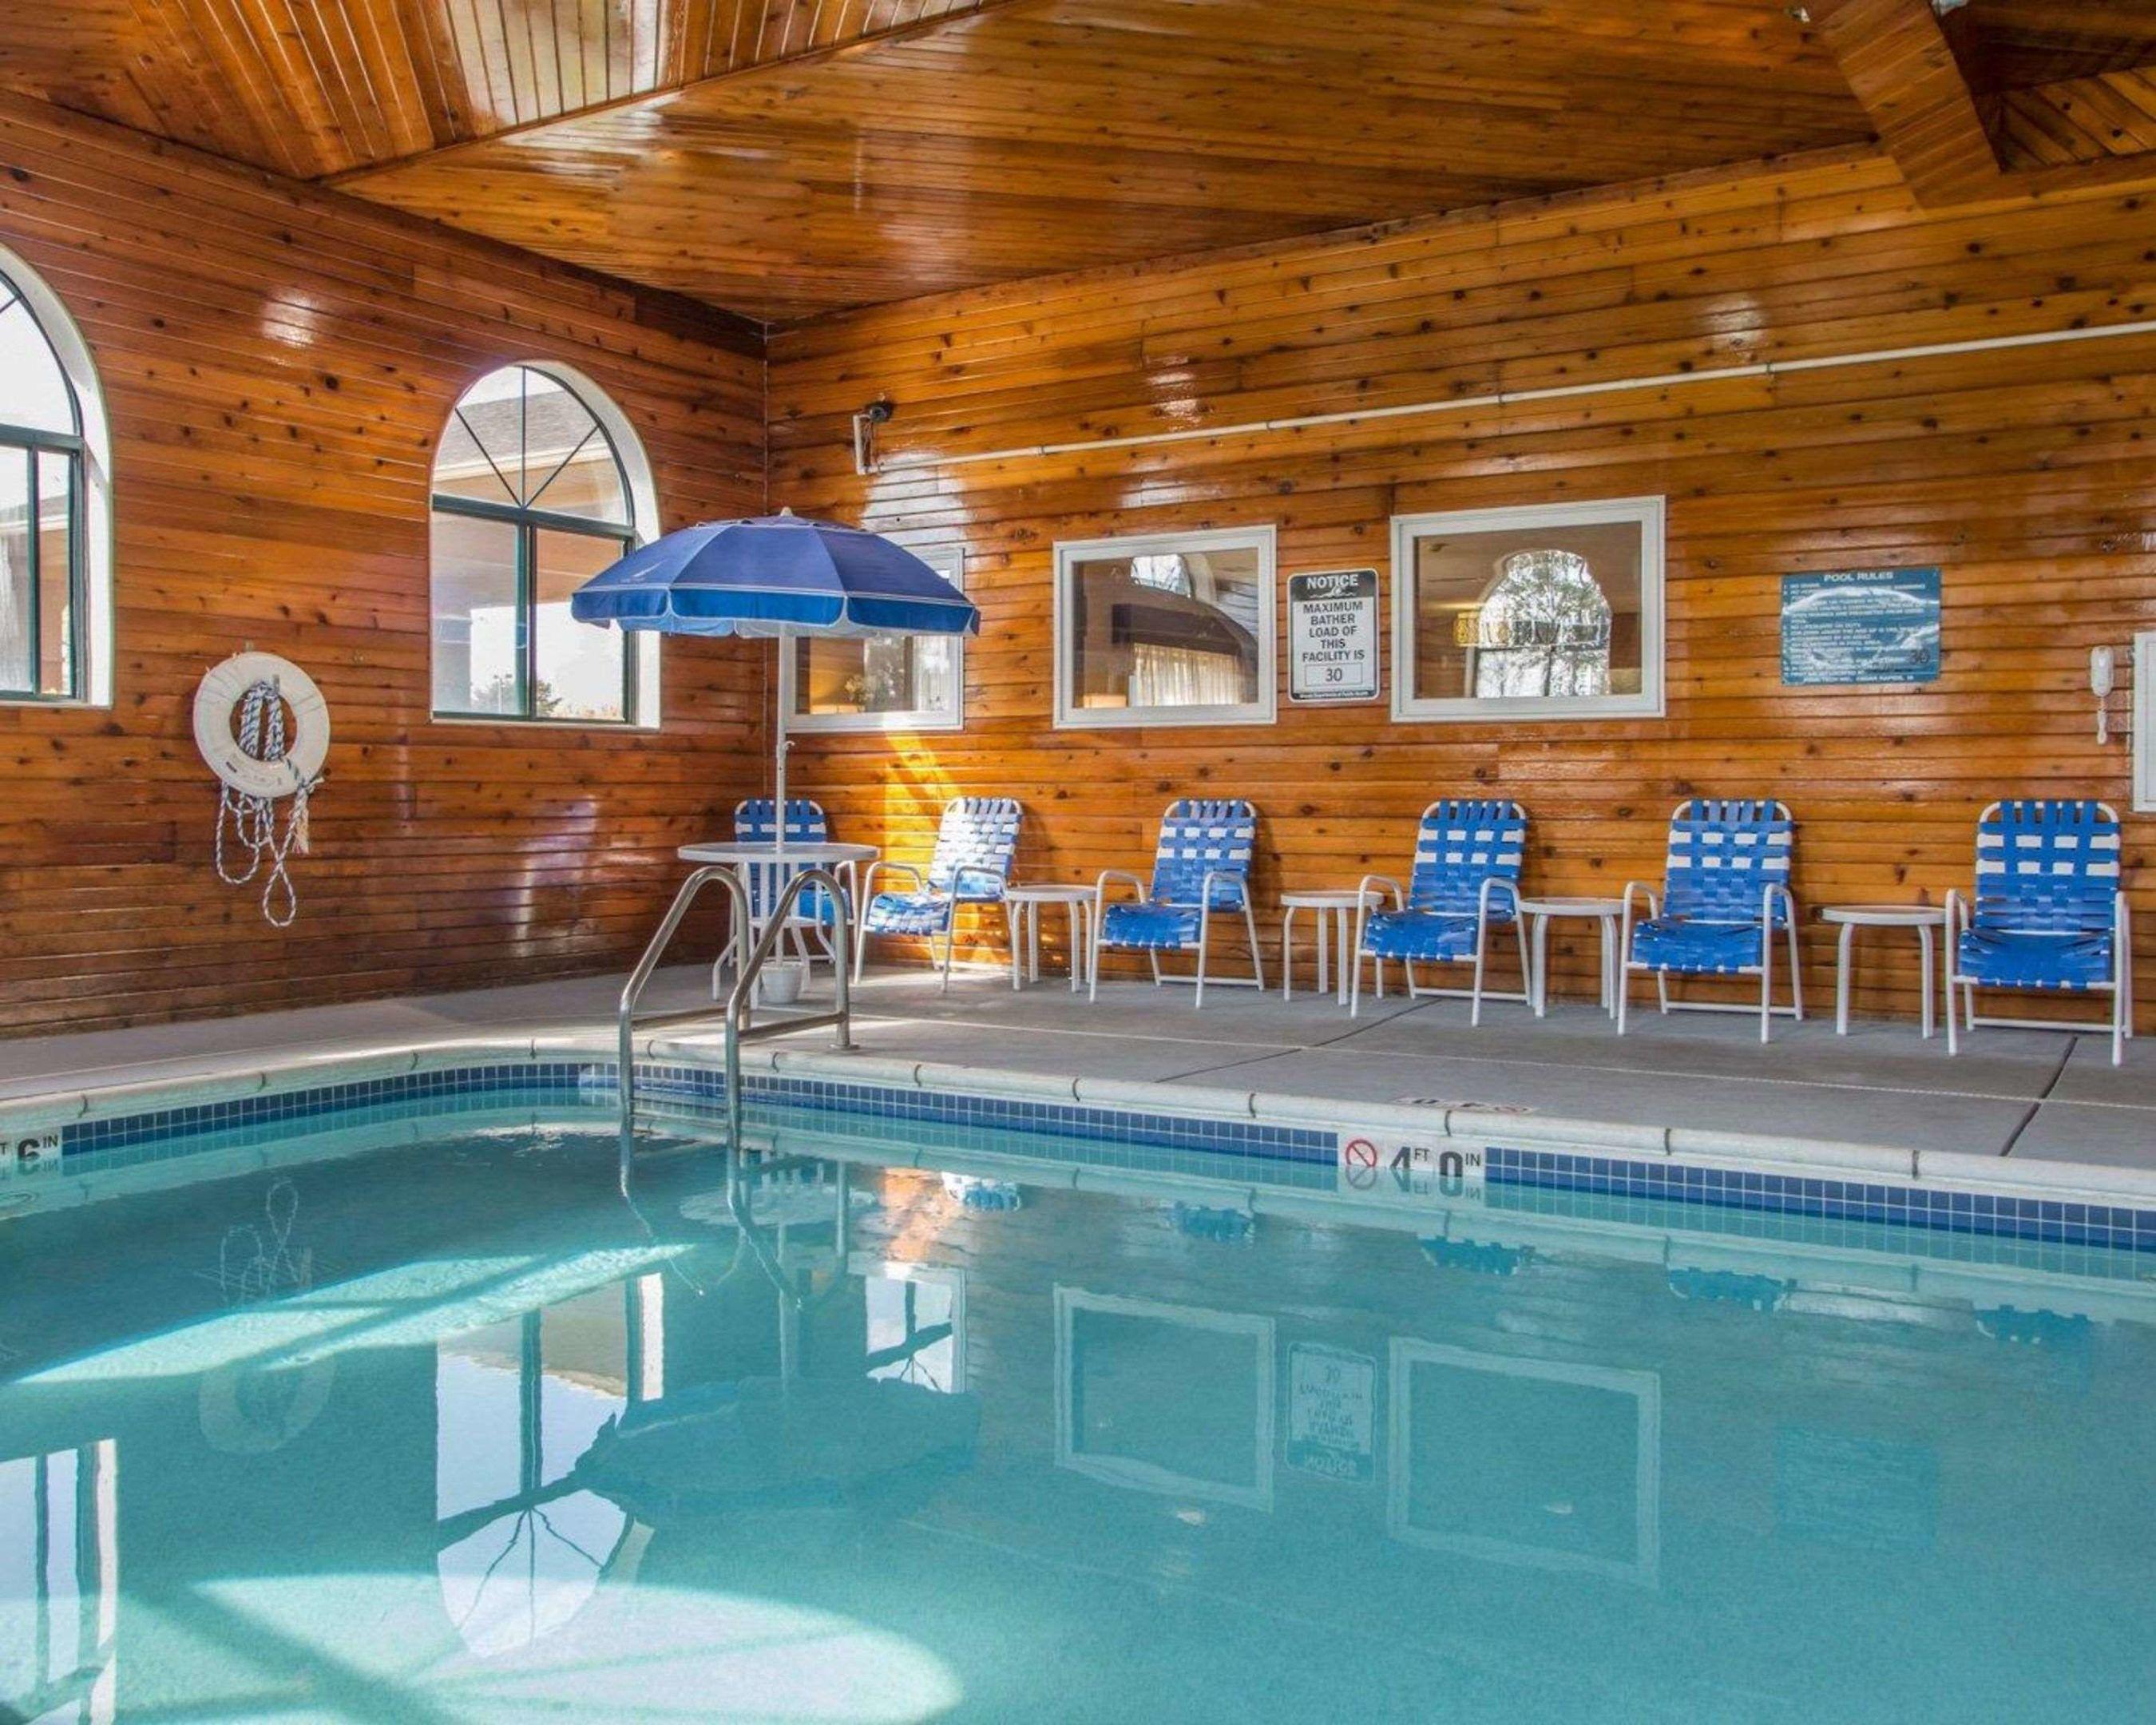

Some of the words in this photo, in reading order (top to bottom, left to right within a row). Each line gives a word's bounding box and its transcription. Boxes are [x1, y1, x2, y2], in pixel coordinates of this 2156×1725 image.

[1307, 574, 1359, 589] NOTICE
[1824, 573, 1854, 582] POOL
[1857, 571, 1893, 580] RULES
[1303, 601, 1363, 613] MAXIMUM
[1310, 613, 1355, 625] BATHER
[1309, 627, 1339, 638] LOAD
[1342, 625, 1357, 636] OF
[1321, 639, 1346, 649] THIS
[1302, 651, 1350, 662] FACILITY
[1355, 649, 1365, 660] IS
[1326, 668, 1343, 682] 30
[42, 1134, 58, 1148] IN
[1413, 1148, 1429, 1161] FT
[1465, 1153, 1481, 1166] IN
